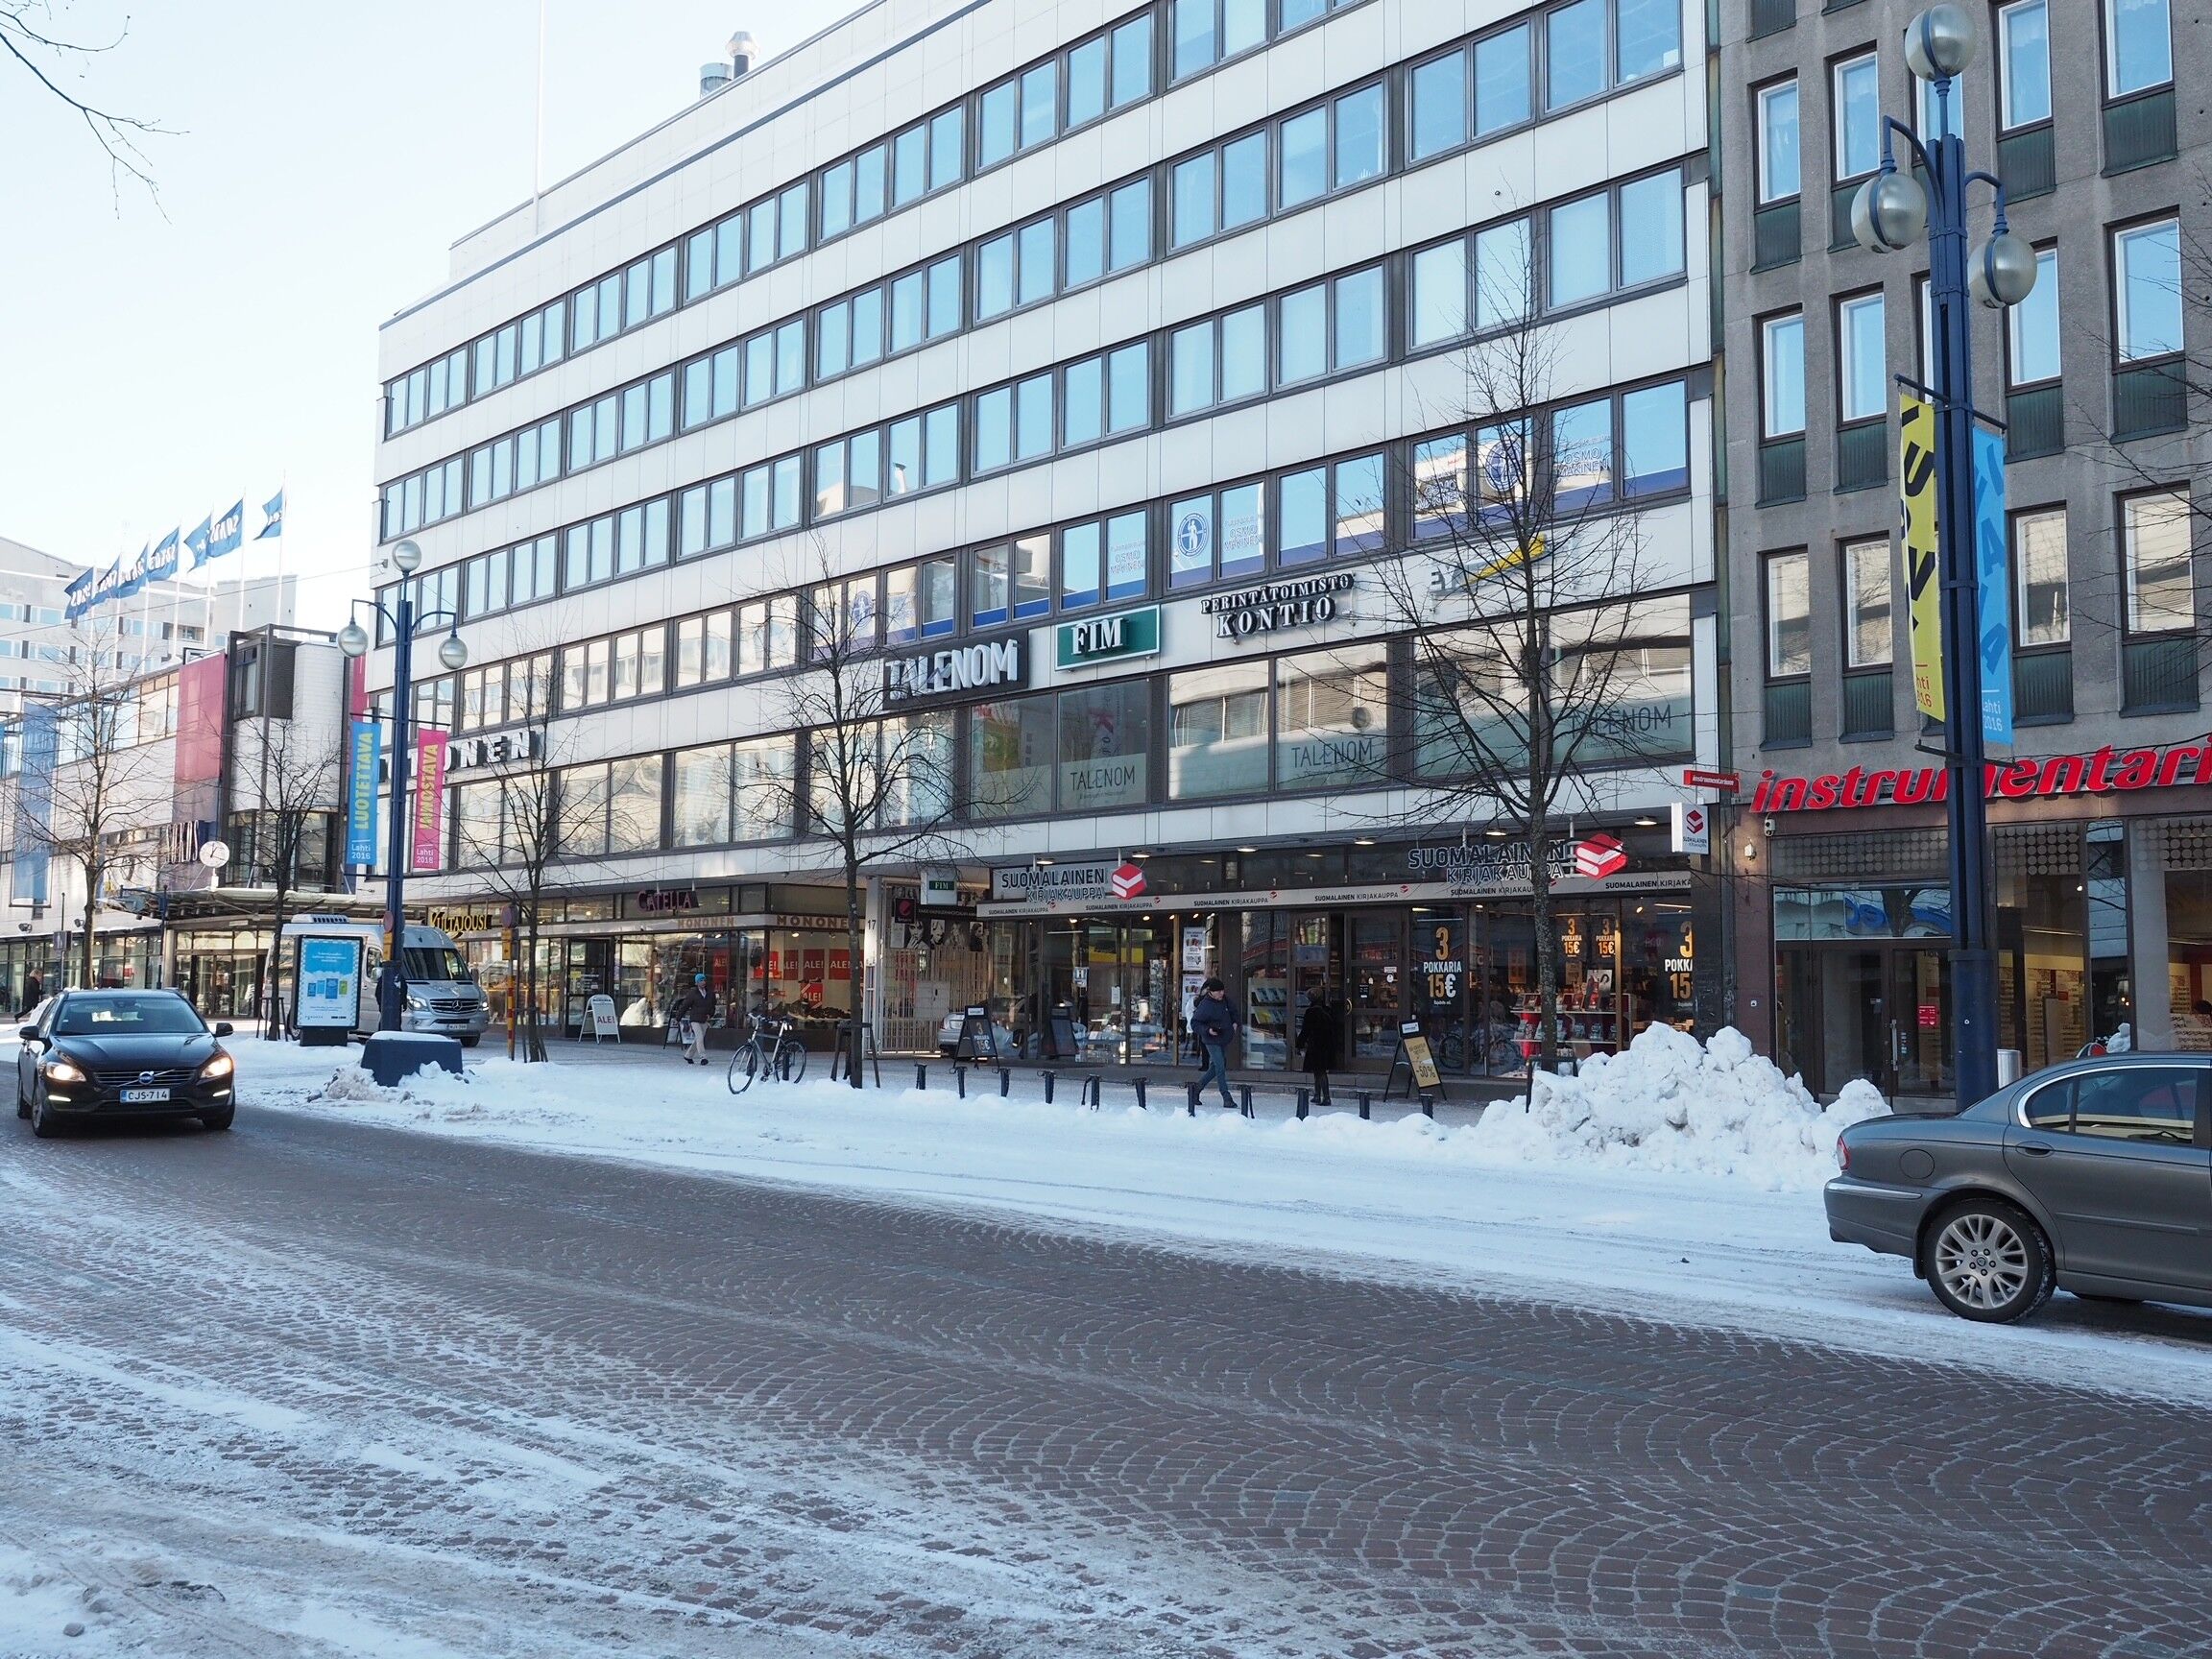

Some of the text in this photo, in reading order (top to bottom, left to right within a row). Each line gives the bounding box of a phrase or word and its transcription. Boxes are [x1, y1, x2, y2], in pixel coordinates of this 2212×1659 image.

[1201, 574, 1350, 613] PERINTÄTOIMISTO
[1217, 597, 1334, 637] KONTIO
[1071, 617, 1123, 656] FIM
[884, 638, 1018, 700] TALENOM
[1291, 737, 1373, 769] TALENOM
[354, 733, 373, 830] LUOTETTAVA
[1070, 765, 1136, 791] TALENOM
[1692, 776, 1734, 786] instrumentarium
[351, 844, 371, 853] Lahti
[416, 848, 434, 856] Lahti
[1408, 839, 1567, 870] SUOMALAINN
[1001, 868, 1105, 889] SUOMALAINEN
[1605, 880, 1658, 890] SUOMALAINEN
[1026, 886, 1104, 903] KIRJAKAUPPA
[1314, 891, 1399, 902] SUOMALAINEN KIRJAKAUPPA
[1451, 887, 1497, 897] SUOMALAINEN
[637, 889, 693, 912] CATELLA
[1193, 897, 1269, 907] SUOMALAINEN KIRJAKAUPPA
[431, 911, 488, 938] KULTAJOUSI
[677, 917, 735, 928] MONONEN
[867, 919, 877, 930] 17
[1568, 918, 1575, 935] 3
[1602, 918, 1610, 935] 3
[1435, 926, 1450, 961] 3
[1680, 921, 1693, 958] 3
[1563, 941, 1580, 954] 15€
[1598, 941, 1615, 954] 15€
[804, 960, 824, 969] ALE!
[830, 960, 851, 969] ALE!
[1423, 961, 1462, 974] POKKARIA
[1428, 974, 1456, 998] 15€
[596, 1015, 615, 1024] ALE!
[1415, 1066, 1436, 1078] -50%
[128, 1091, 167, 1100] CJS-714
